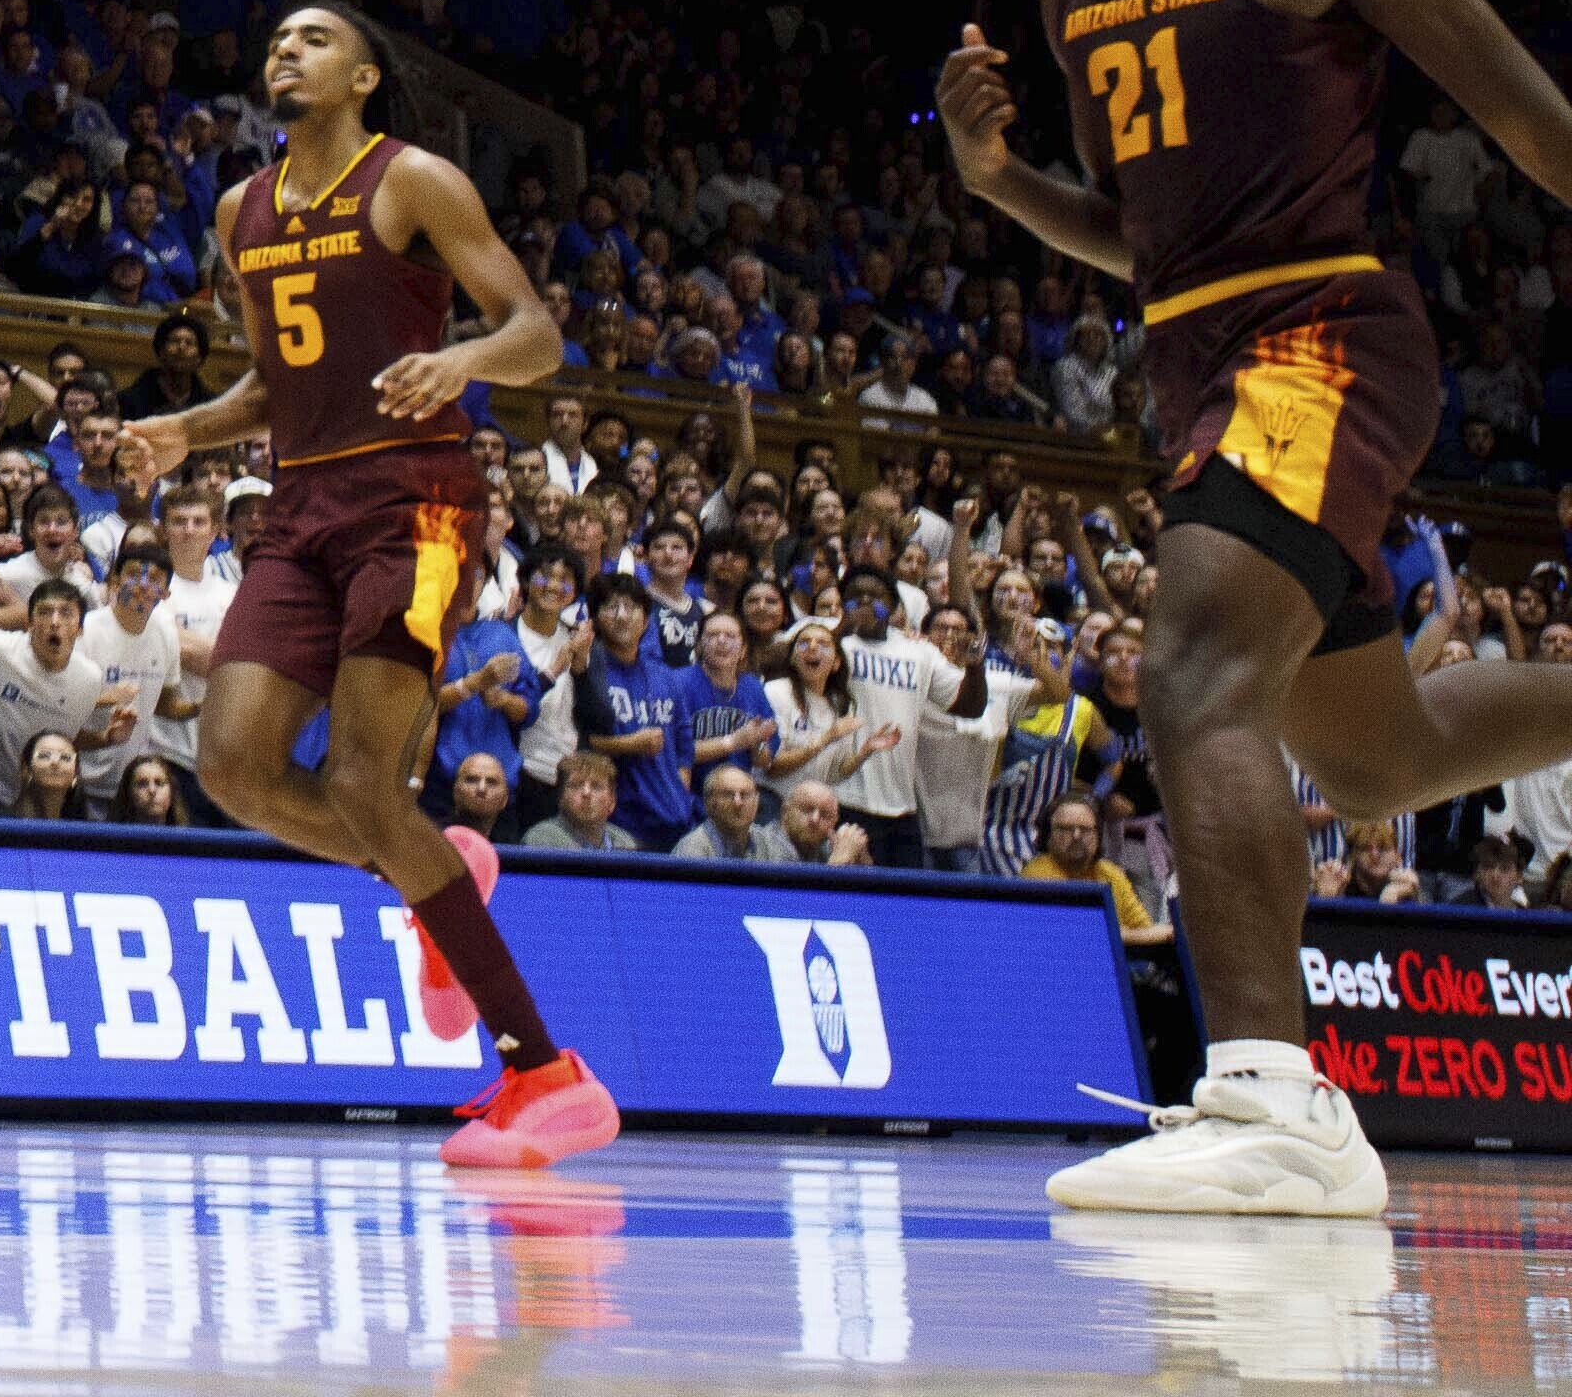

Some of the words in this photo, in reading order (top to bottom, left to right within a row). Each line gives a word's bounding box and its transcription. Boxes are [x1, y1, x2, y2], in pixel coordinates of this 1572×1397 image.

[1086, 26, 1189, 163] 21
[239, 239, 303, 274] ARIZONA
[307, 229, 362, 261] STATE
[273, 272, 325, 367] 5
[853, 649, 917, 690] DUKE
[1299, 947, 1399, 1010] Best
[1397, 949, 1487, 1016] Coke
[1386, 1034, 1507, 1100] ZERO
